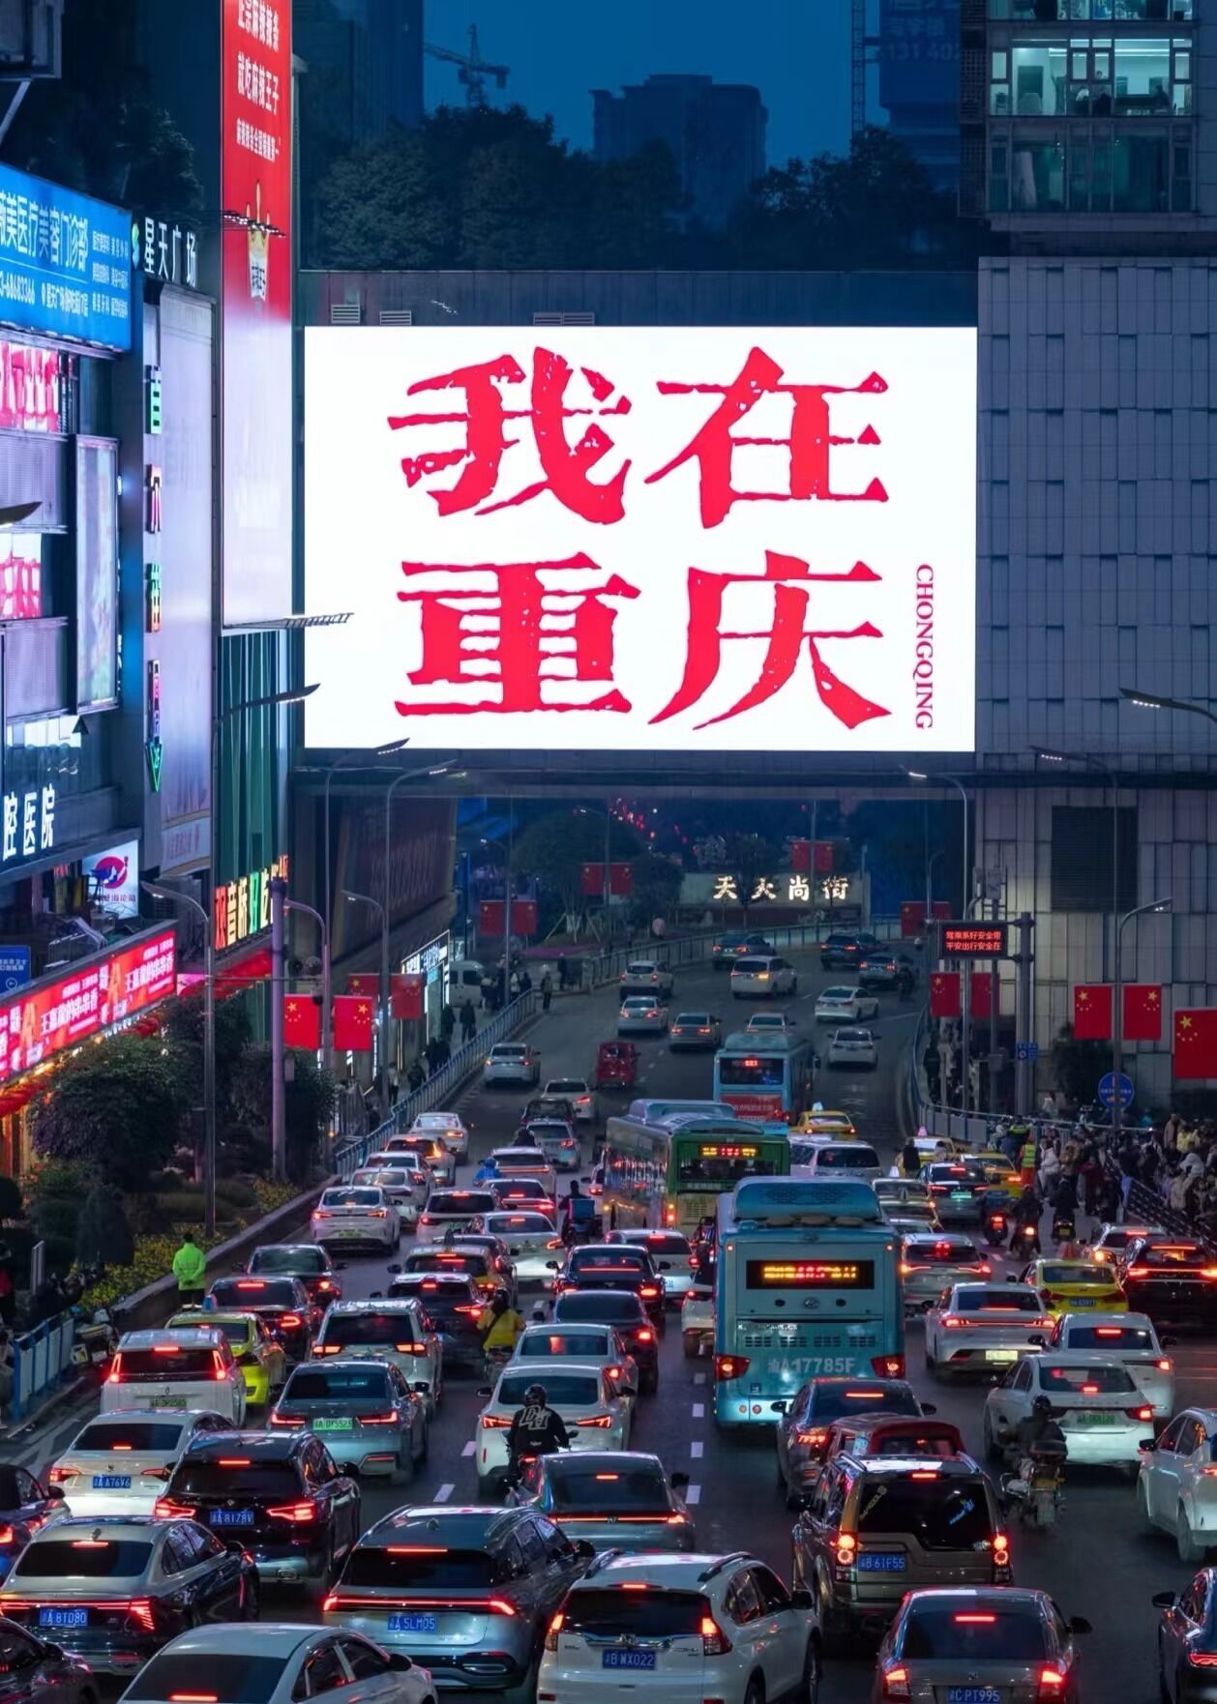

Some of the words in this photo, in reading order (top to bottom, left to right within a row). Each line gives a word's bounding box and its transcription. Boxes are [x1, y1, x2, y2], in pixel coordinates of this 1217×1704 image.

[144, 216, 196, 288] 星天广场
[387, 346, 889, 529] 我在
[394, 550, 892, 731] 重庆
[912, 564, 935, 730] CHONGQING
[3, 783, 56, 861] 腔医院
